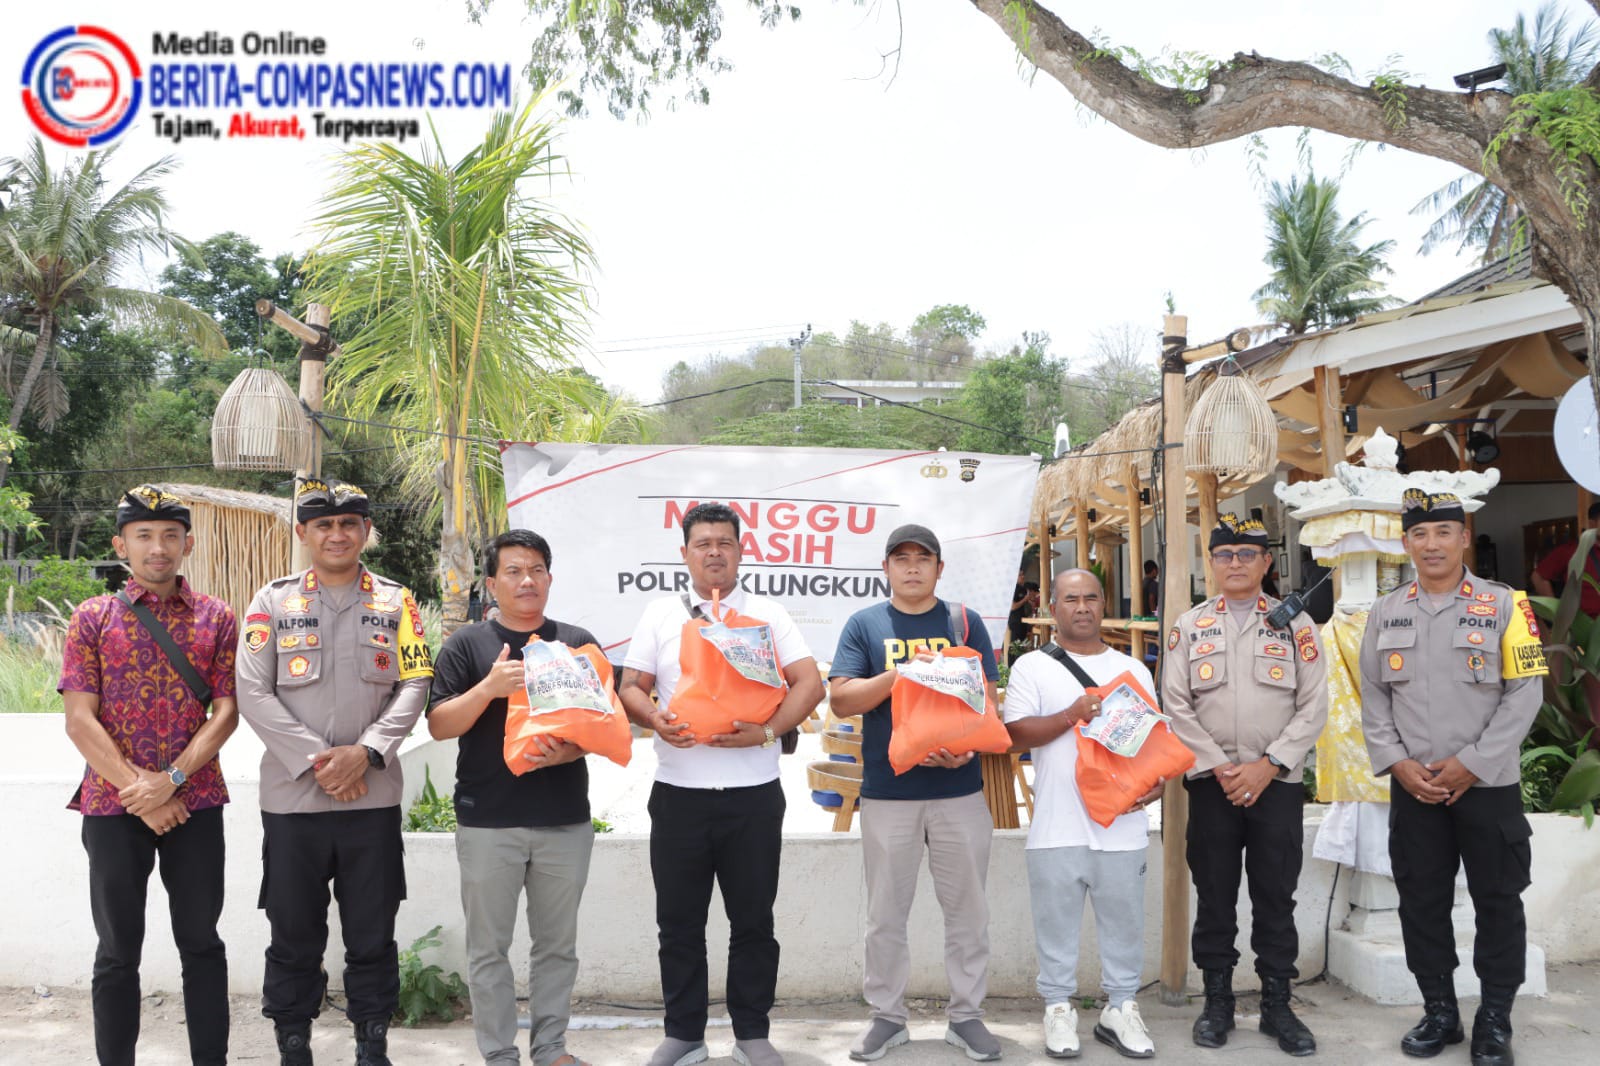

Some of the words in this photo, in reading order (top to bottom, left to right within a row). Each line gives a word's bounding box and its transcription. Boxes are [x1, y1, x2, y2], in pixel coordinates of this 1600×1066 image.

[664, 500, 876, 535] MNGGU
[741, 531, 834, 565] ASIH
[617, 571, 690, 594] POLR
[736, 573, 892, 598] KLUNGKUN
[361, 615, 399, 631] POLRI
[1458, 617, 1497, 630] POLRI
[1258, 628, 1292, 642] POLRI
